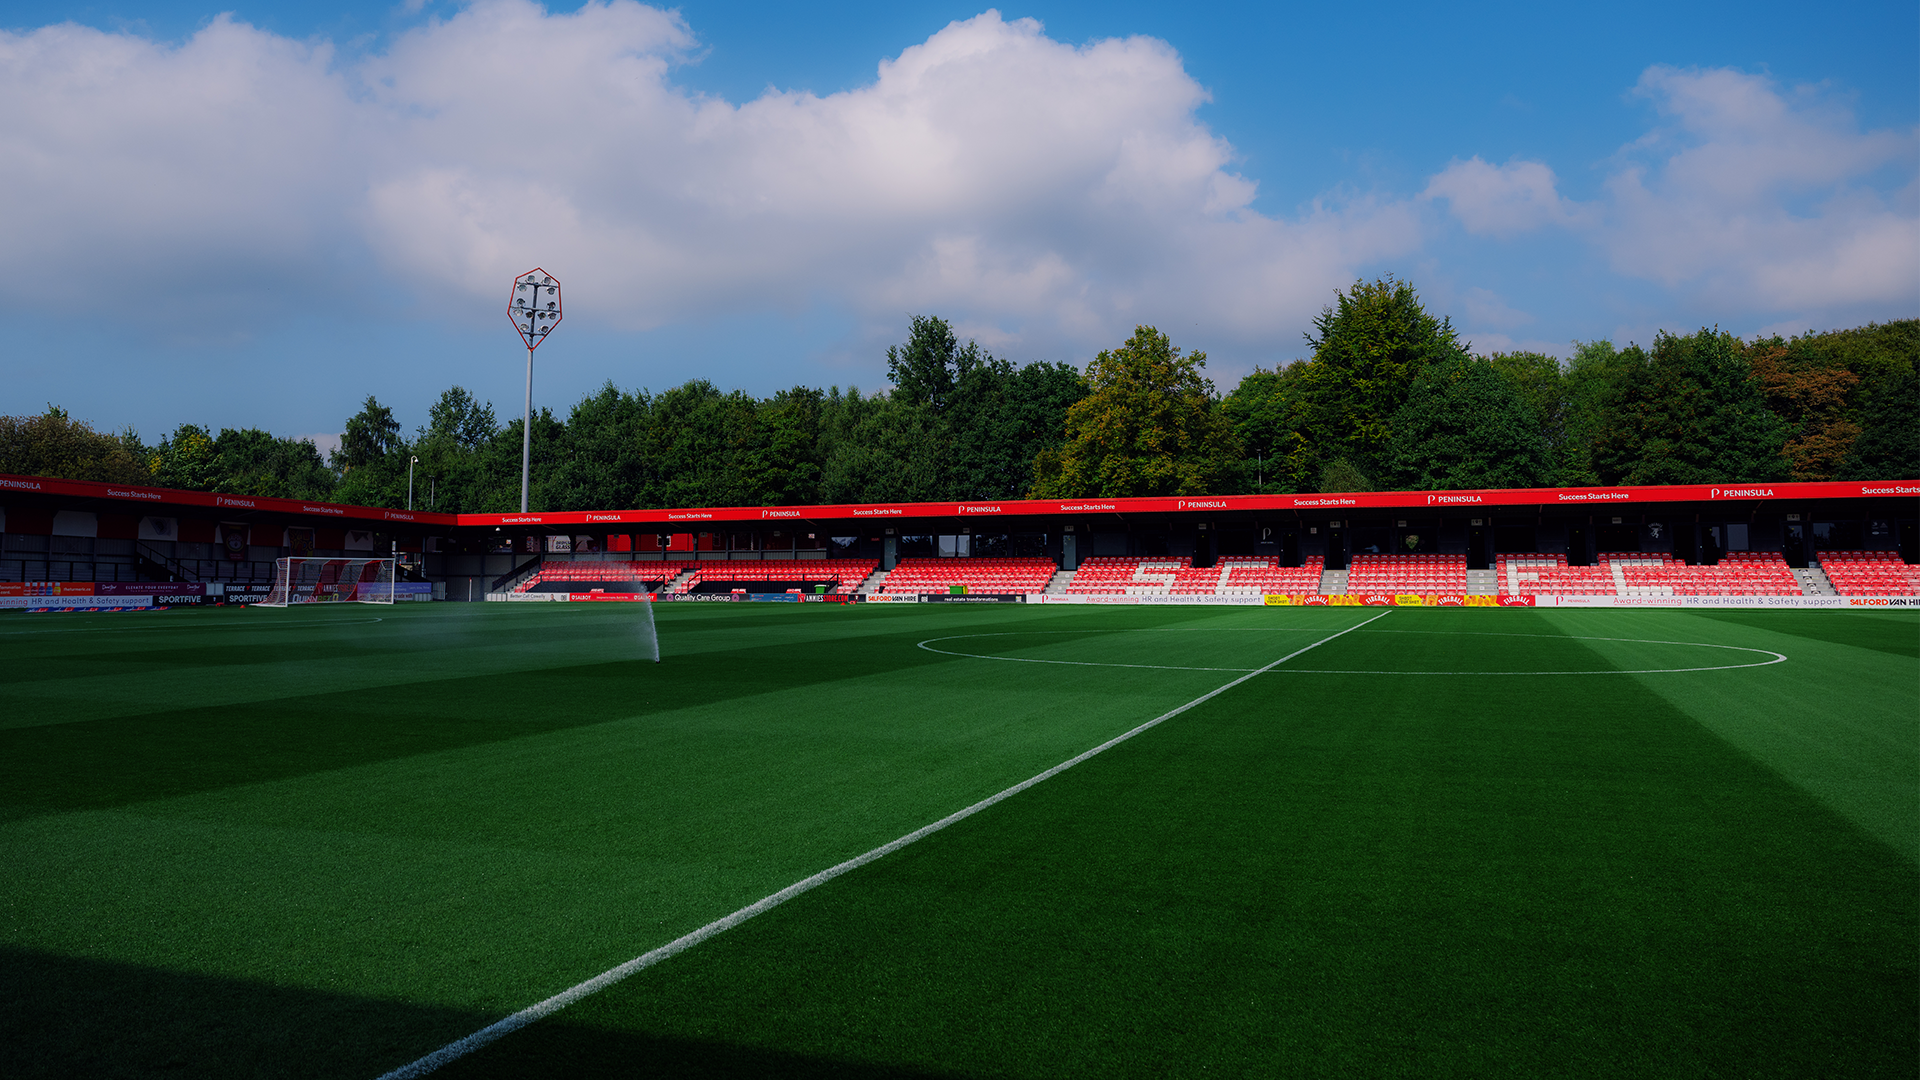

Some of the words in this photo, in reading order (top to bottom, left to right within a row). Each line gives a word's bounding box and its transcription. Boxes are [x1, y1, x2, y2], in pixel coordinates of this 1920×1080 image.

[107, 489, 129, 497] Success
[1723, 489, 1774, 497] PENINSULA
[1862, 487, 1894, 495] Success
[1895, 486, 1920, 494] Starts
[224, 499, 255, 507] PENINSULA
[1438, 495, 1482, 503] PENINSULA
[390, 512, 414, 520] PENINSULA
[96, 597, 120, 605] Safety
[674, 594, 696, 602] Quality
[711, 594, 731, 602] Group
[1304, 595, 1328, 605] FIREBALL
[1365, 595, 1390, 605] FIREBALL
[1438, 596, 1463, 606] FIREBALL
[1503, 595, 1530, 605] FIREBALL
[1613, 597, 1682, 606] Award-winning
[1768, 598, 1800, 606] Safety
[1803, 598, 1842, 606] support
